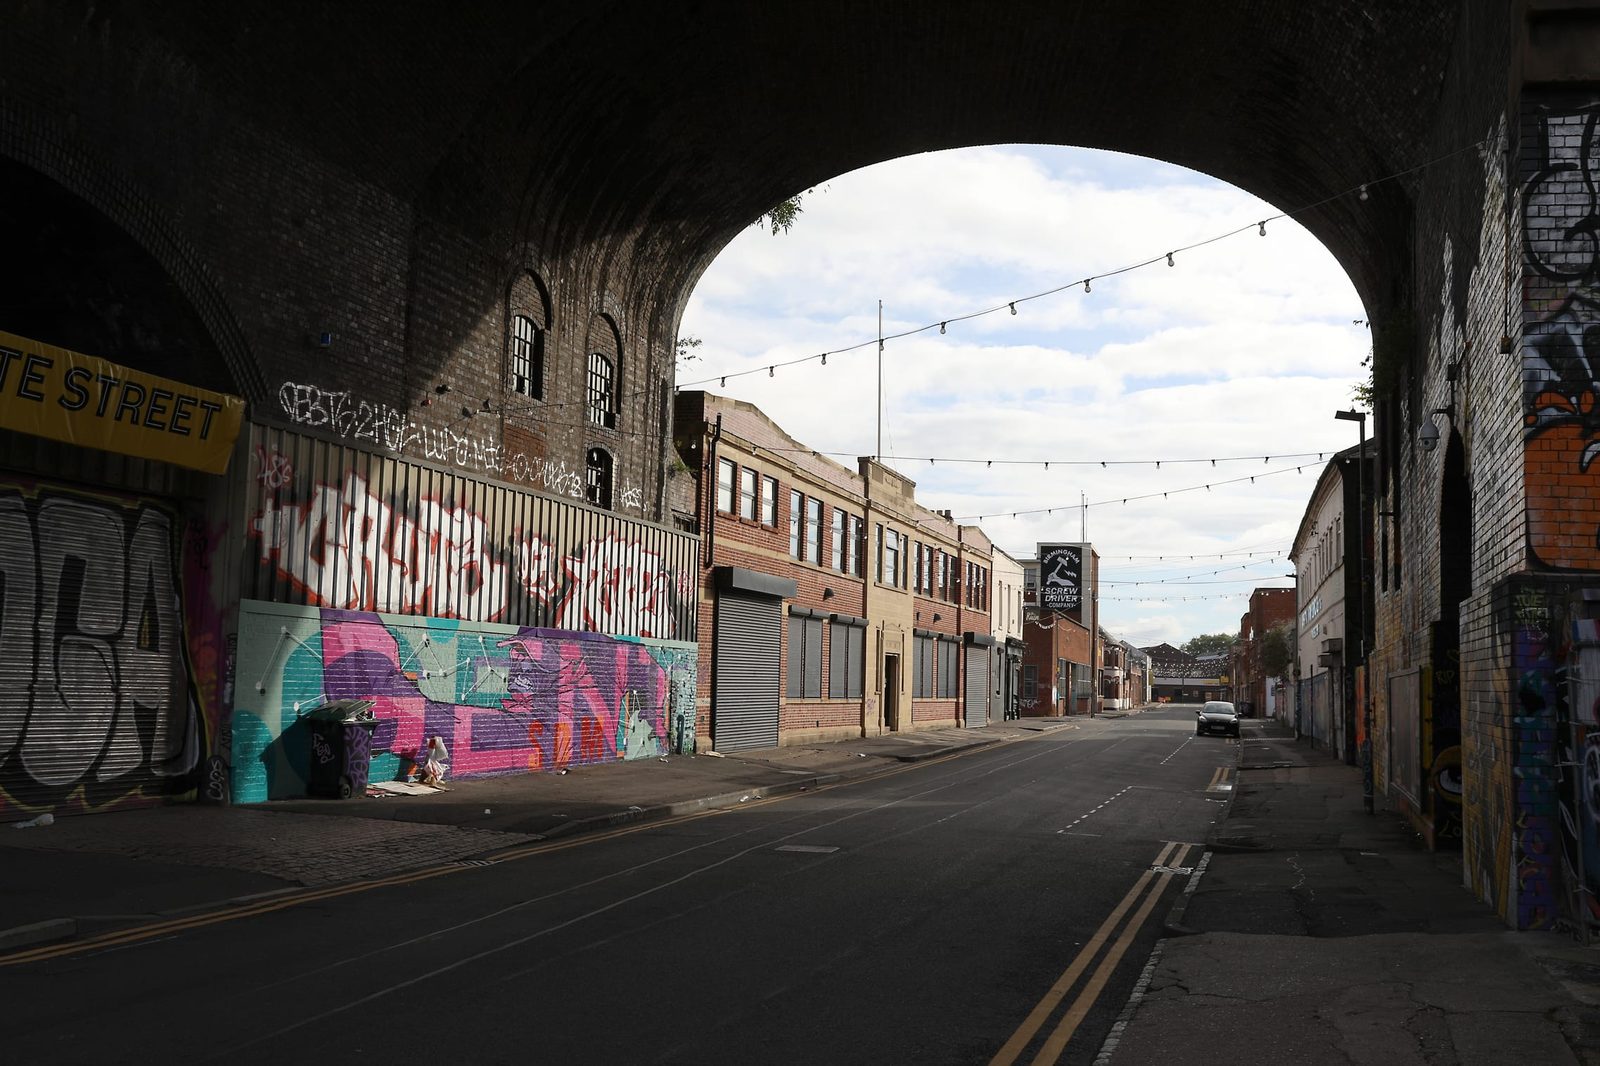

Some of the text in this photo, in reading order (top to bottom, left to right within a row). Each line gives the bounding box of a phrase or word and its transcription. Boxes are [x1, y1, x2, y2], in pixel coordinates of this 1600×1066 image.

[58, 365, 222, 440] STREET
[1043, 549, 1080, 564] BIRMINGHAM
[1045, 587, 1078, 595] SCREW
